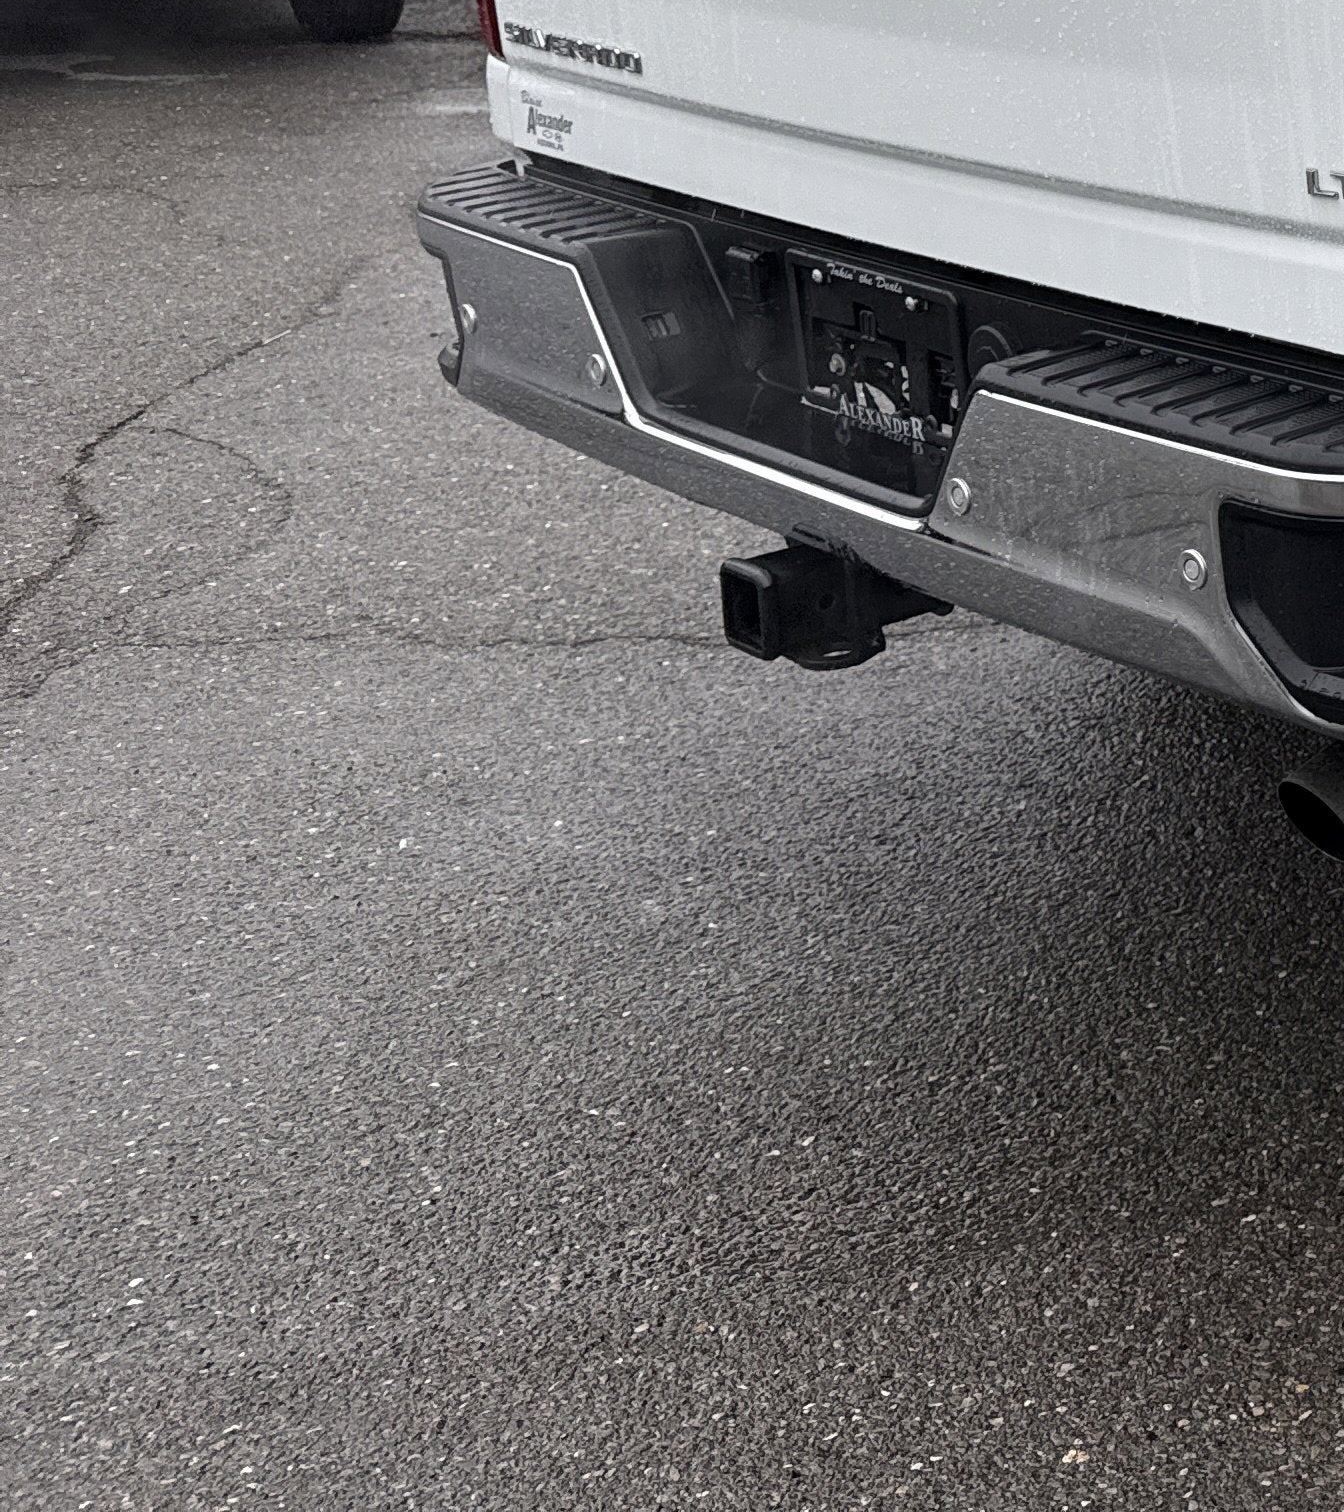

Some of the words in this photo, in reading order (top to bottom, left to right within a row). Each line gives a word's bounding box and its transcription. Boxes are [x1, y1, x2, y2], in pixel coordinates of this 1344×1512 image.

[504, 21, 643, 75] SILVERADO
[858, 273, 873, 286] the
[839, 392, 926, 442] ALEXANDER
